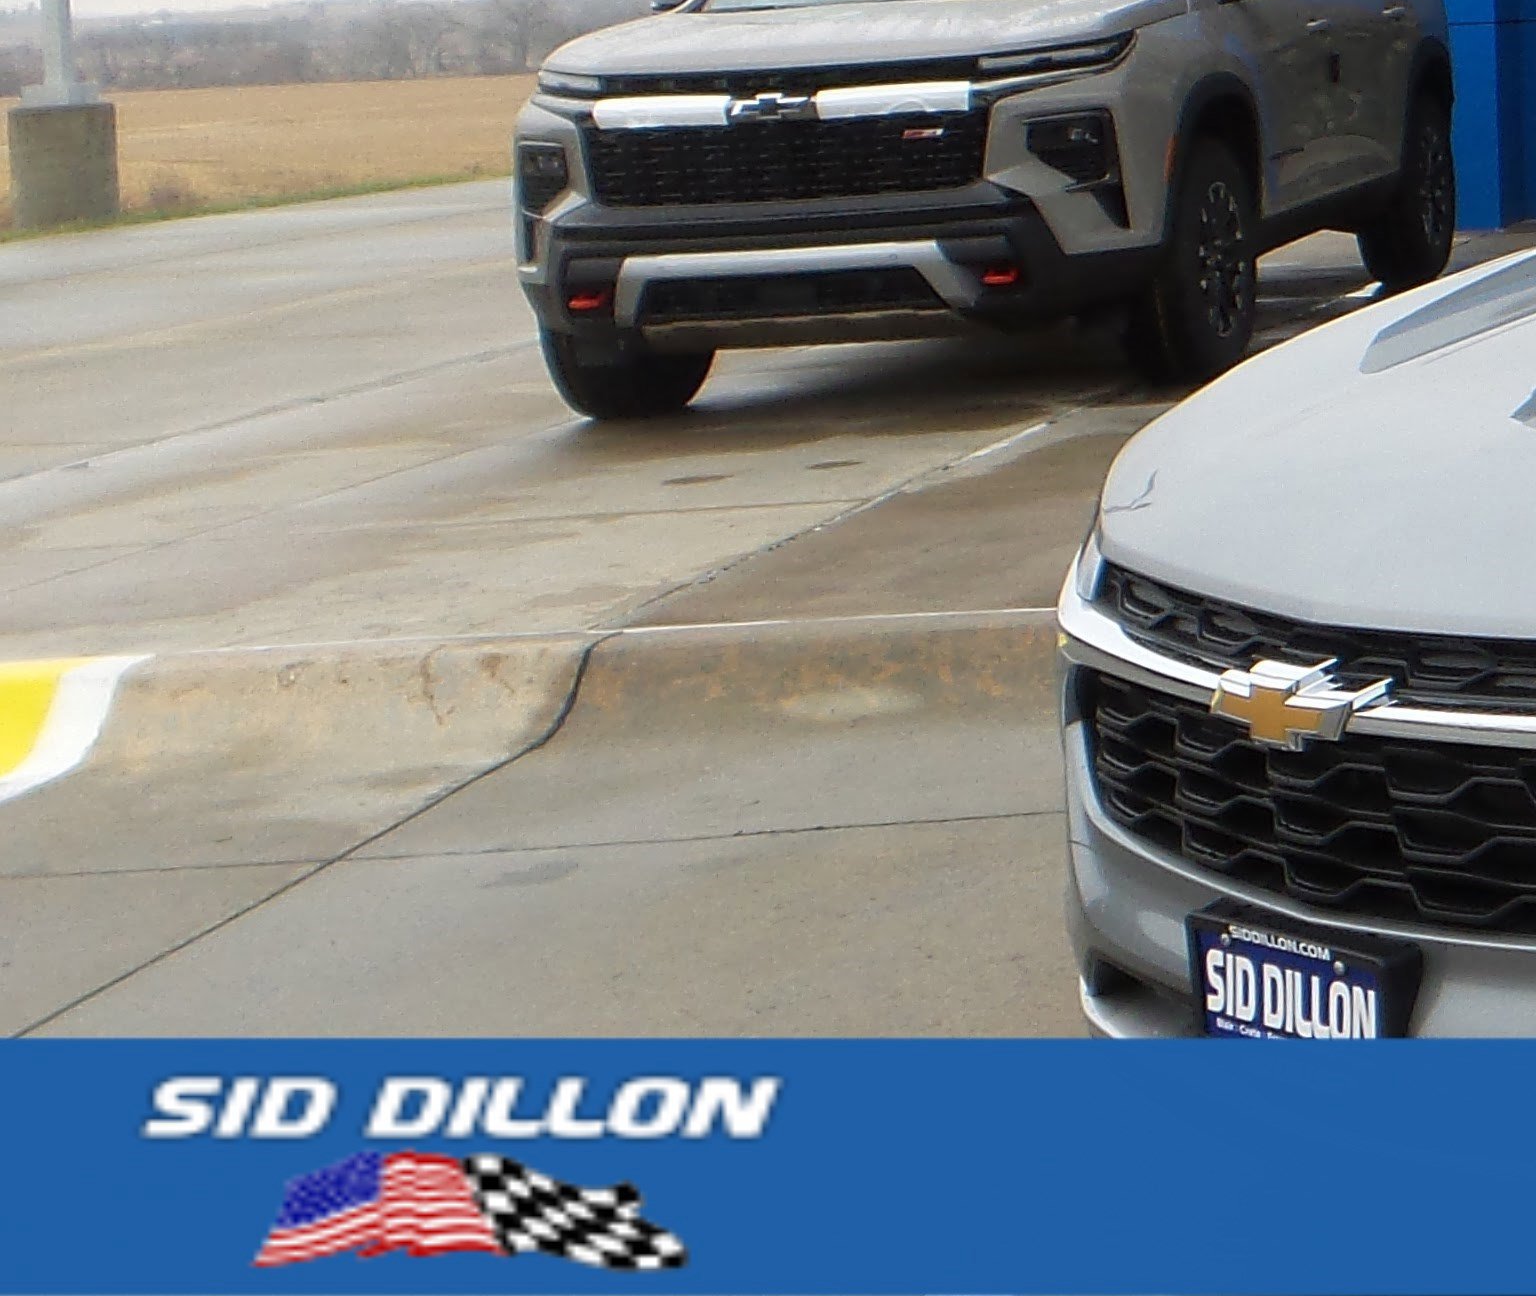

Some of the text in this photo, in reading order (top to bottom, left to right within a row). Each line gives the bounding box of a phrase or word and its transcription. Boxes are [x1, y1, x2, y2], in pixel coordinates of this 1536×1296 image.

[1228, 925, 1331, 961] SIDDILLON.COM
[1206, 949, 1376, 1039] SID DILLON
